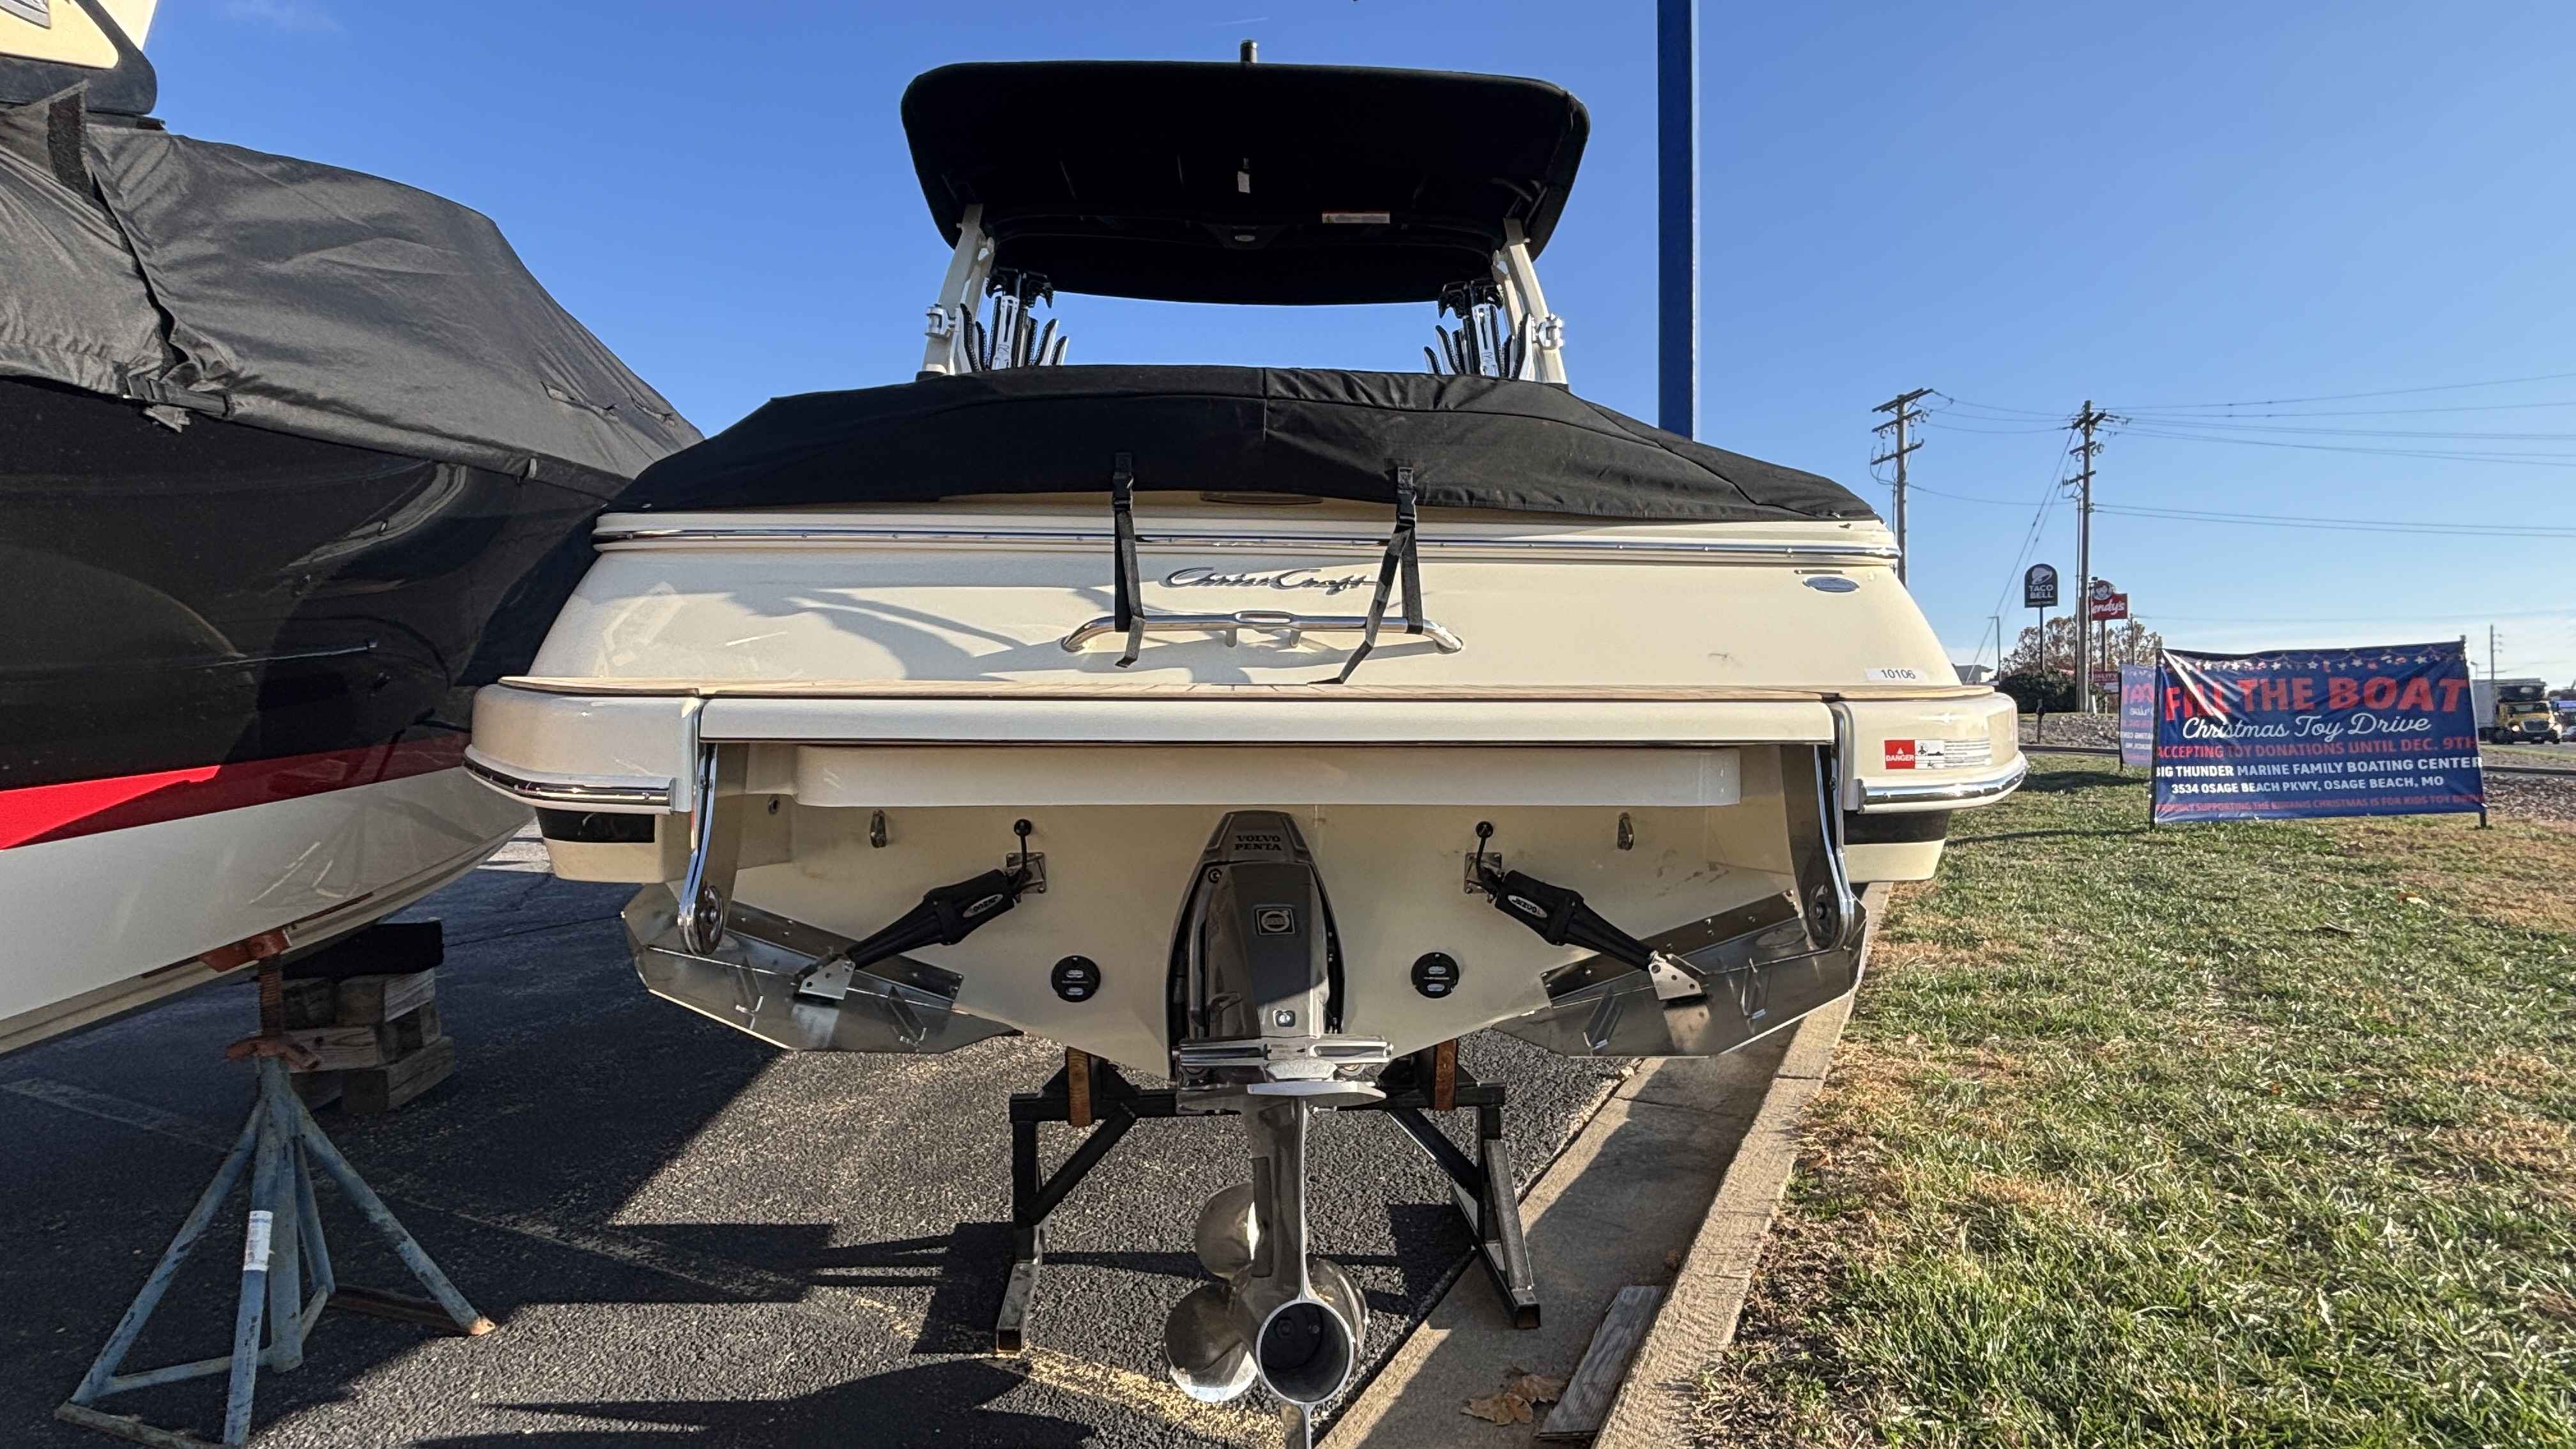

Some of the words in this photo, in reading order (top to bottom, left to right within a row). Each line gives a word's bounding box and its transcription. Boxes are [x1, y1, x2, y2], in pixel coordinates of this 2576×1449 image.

[2090, 599, 2125, 615] endy's
[2237, 678, 2314, 712] THE
[2328, 677, 2469, 712] BOAT
[2182, 717, 2290, 739] Christmas
[2294, 716, 2344, 742] Toy
[2348, 712, 2432, 735] Drive
[2157, 746, 2224, 758] ACCEPTING
[2226, 745, 2251, 757] TOY
[2256, 742, 2345, 756] DONATIONS
[2349, 740, 2396, 753] UNTIL
[2400, 738, 2438, 751] DEC.
[2175, 765, 2234, 777] THUNDER
[2237, 764, 2290, 776] MARINE
[2292, 762, 2343, 774] FAMILY
[2347, 759, 2414, 772] BOATING
[2418, 756, 2483, 770] CENTER
[2172, 784, 2199, 793] 3534
[2201, 783, 2239, 793] OSAGE
[2241, 782, 2280, 792] BEACH
[2282, 781, 2321, 792] PKWY,
[2324, 779, 2366, 790] OSAGE
[2369, 778, 2418, 788] BEACH,
[2421, 776, 2444, 786] MO
[2313, 798, 2367, 808] CHRISTMAS
[2381, 797, 2402, 806] FOR
[2404, 796, 2428, 804] KIDS
[2429, 795, 2450, 803] TOY
